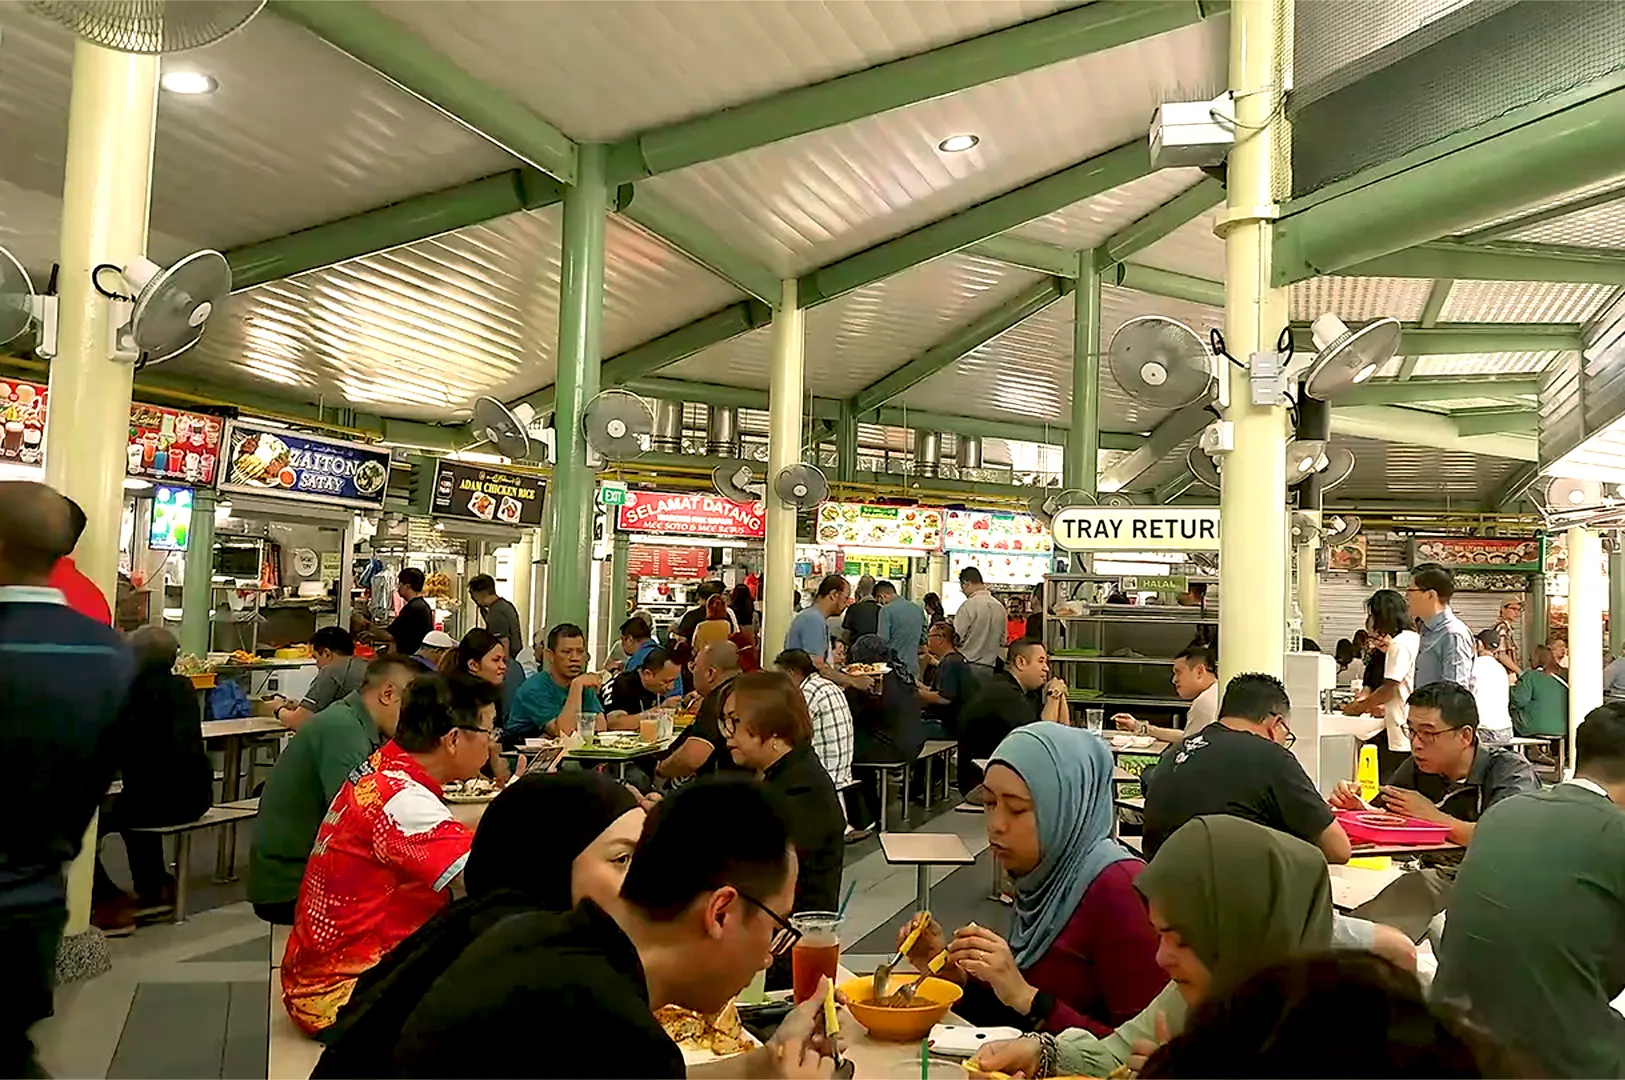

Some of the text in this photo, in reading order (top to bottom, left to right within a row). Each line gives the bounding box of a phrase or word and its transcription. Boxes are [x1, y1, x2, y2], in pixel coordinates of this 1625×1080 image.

[289, 448, 359, 476] ZAITON
[300, 474, 344, 492] SATAY
[459, 479, 482, 491] ADAM
[483, 482, 518, 497] CHICKEN
[518, 488, 535, 499] RICE
[605, 490, 622, 502] EXIT
[626, 497, 760, 530] SELAMAT DATANG
[664, 522, 688, 531] SOTO
[718, 525, 745, 534] REBUS
[1063, 519, 1220, 539] TRAY RETUR
[1143, 580, 1176, 588] HALAL
